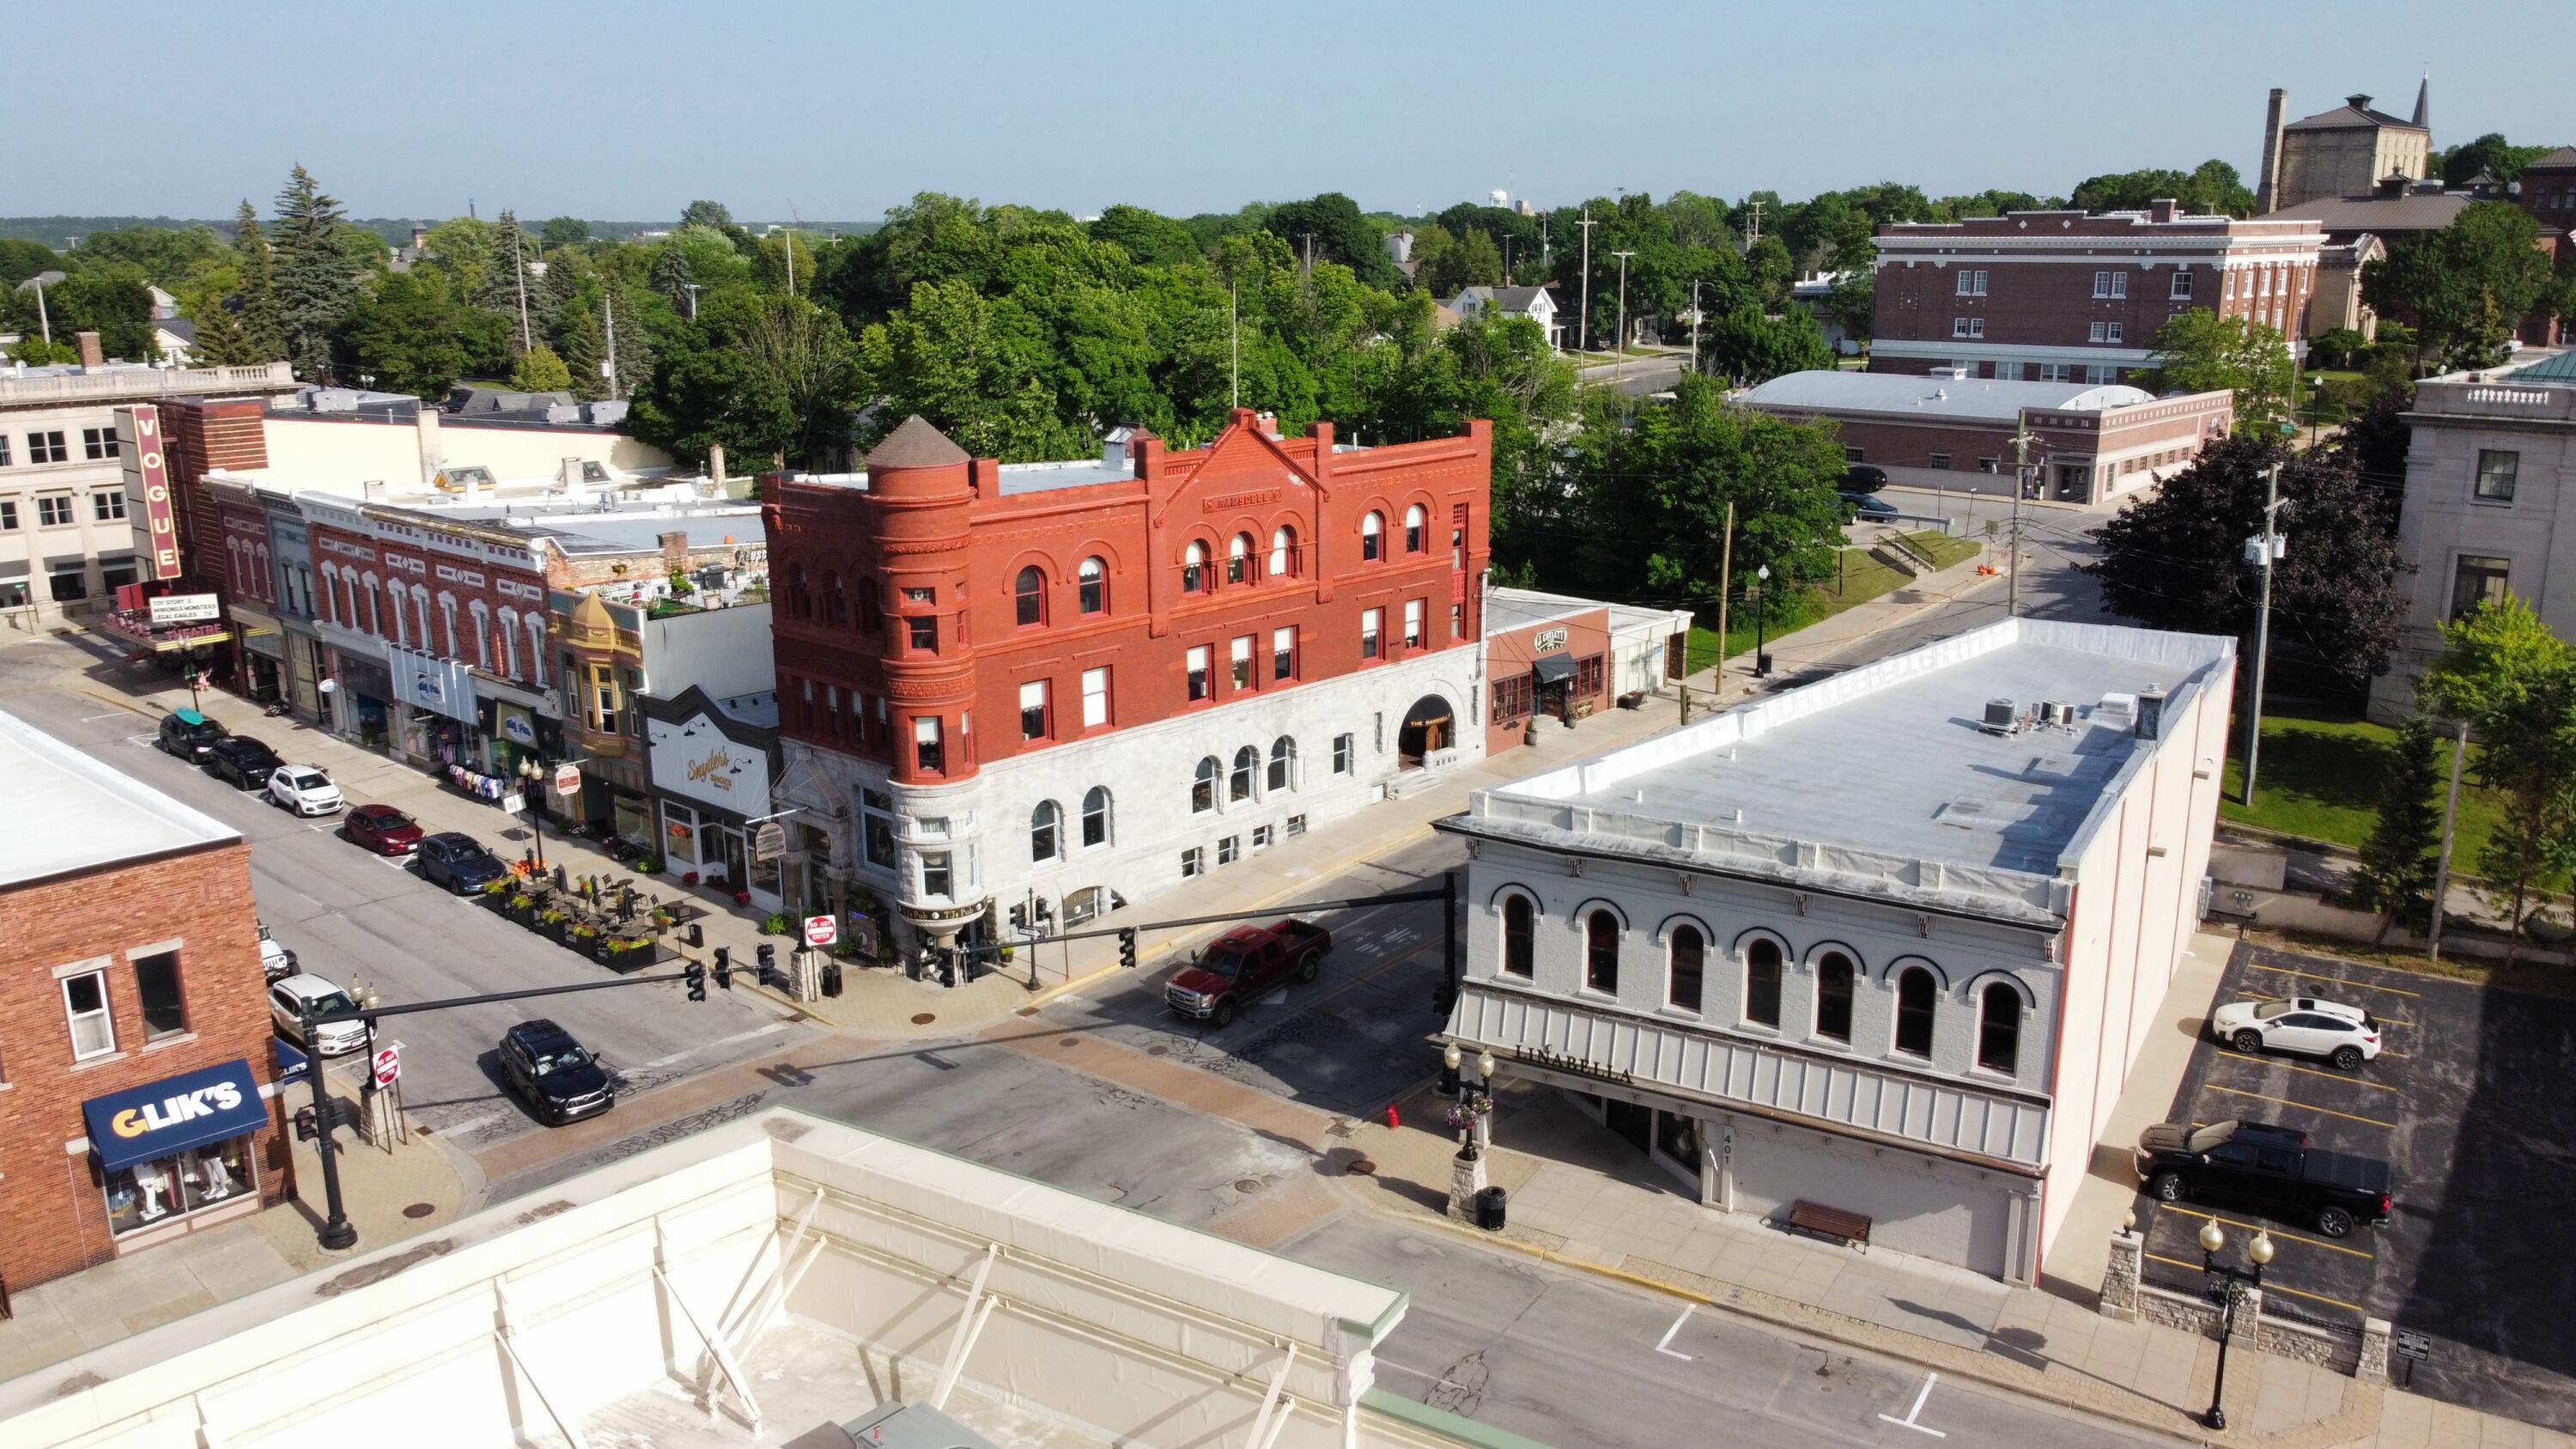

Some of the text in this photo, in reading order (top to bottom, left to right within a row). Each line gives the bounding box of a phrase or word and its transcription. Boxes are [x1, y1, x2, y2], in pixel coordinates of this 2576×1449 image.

[138, 419, 176, 566] VOGUE
[164, 623, 223, 640] THEATRE
[688, 745, 730, 782] Snyder's
[960, 906, 975, 916] Pub
[378, 1052, 395, 1067] DO NOT
[1512, 1044, 1635, 1085] LINABELLA
[380, 1068, 395, 1081] ENTER
[112, 1081, 242, 1138] GLIK'S
